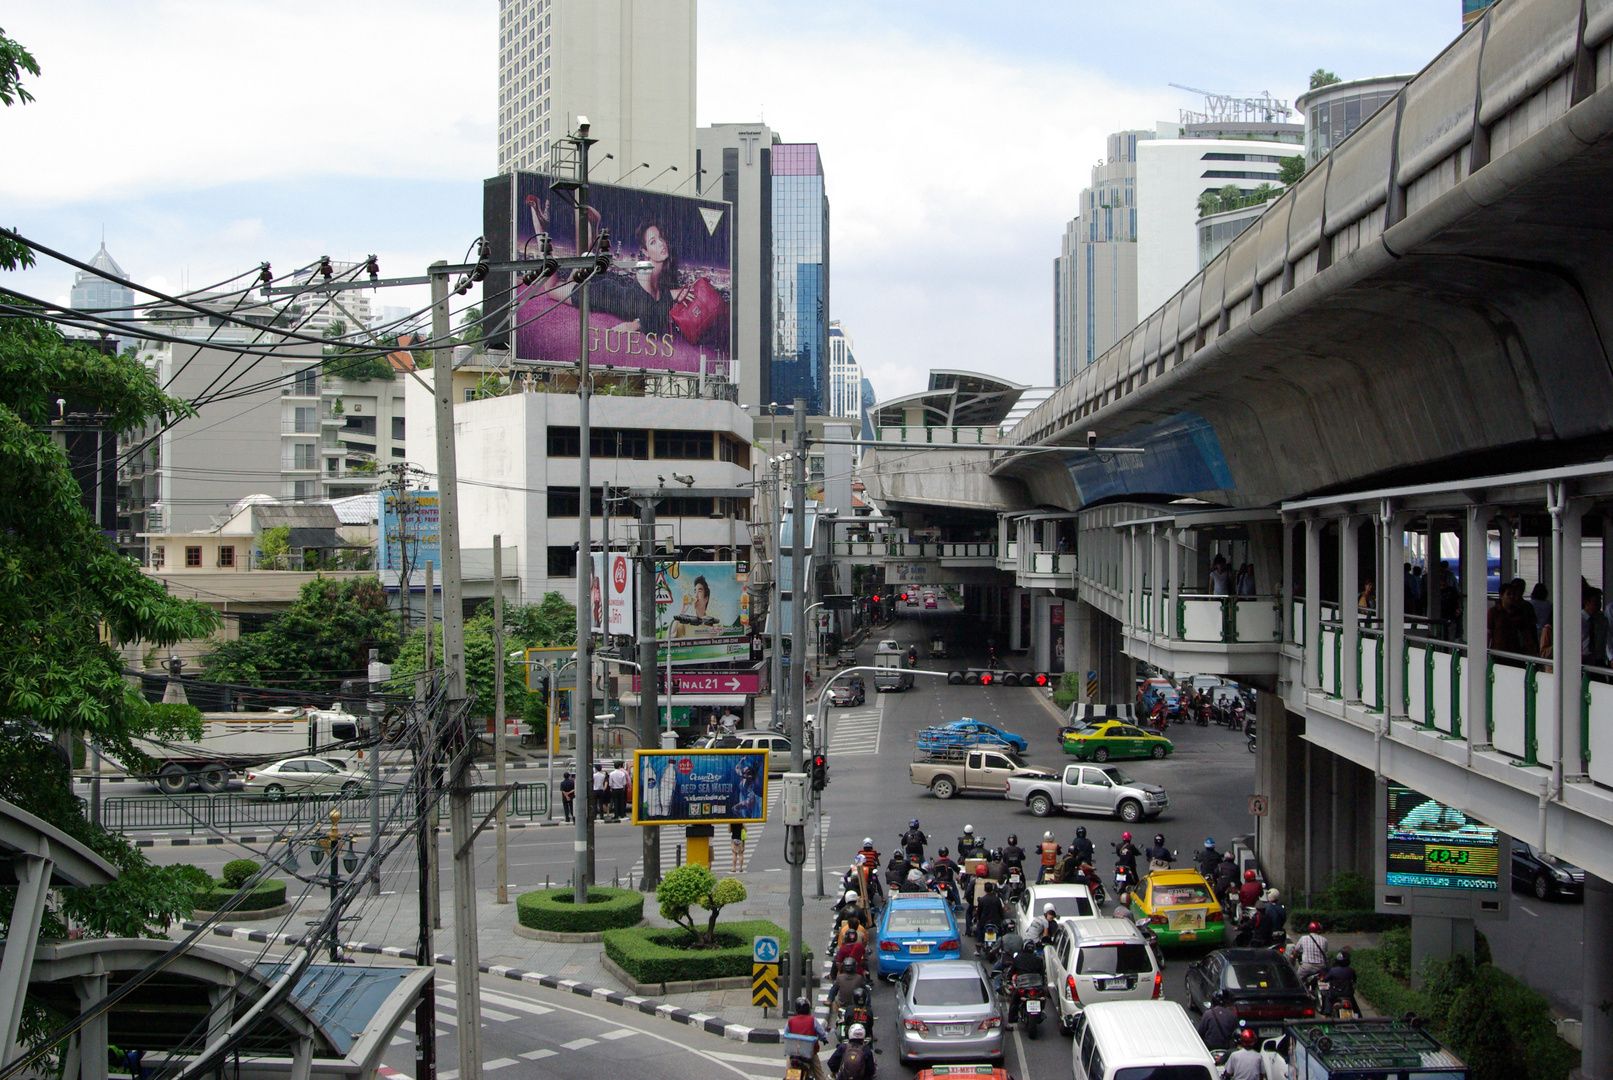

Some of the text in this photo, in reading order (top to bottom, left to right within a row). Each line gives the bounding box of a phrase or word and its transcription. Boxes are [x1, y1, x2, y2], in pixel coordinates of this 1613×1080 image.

[1206, 96, 1288, 114] WESTIN
[681, 783, 733, 793] DEEP SEA WATER
